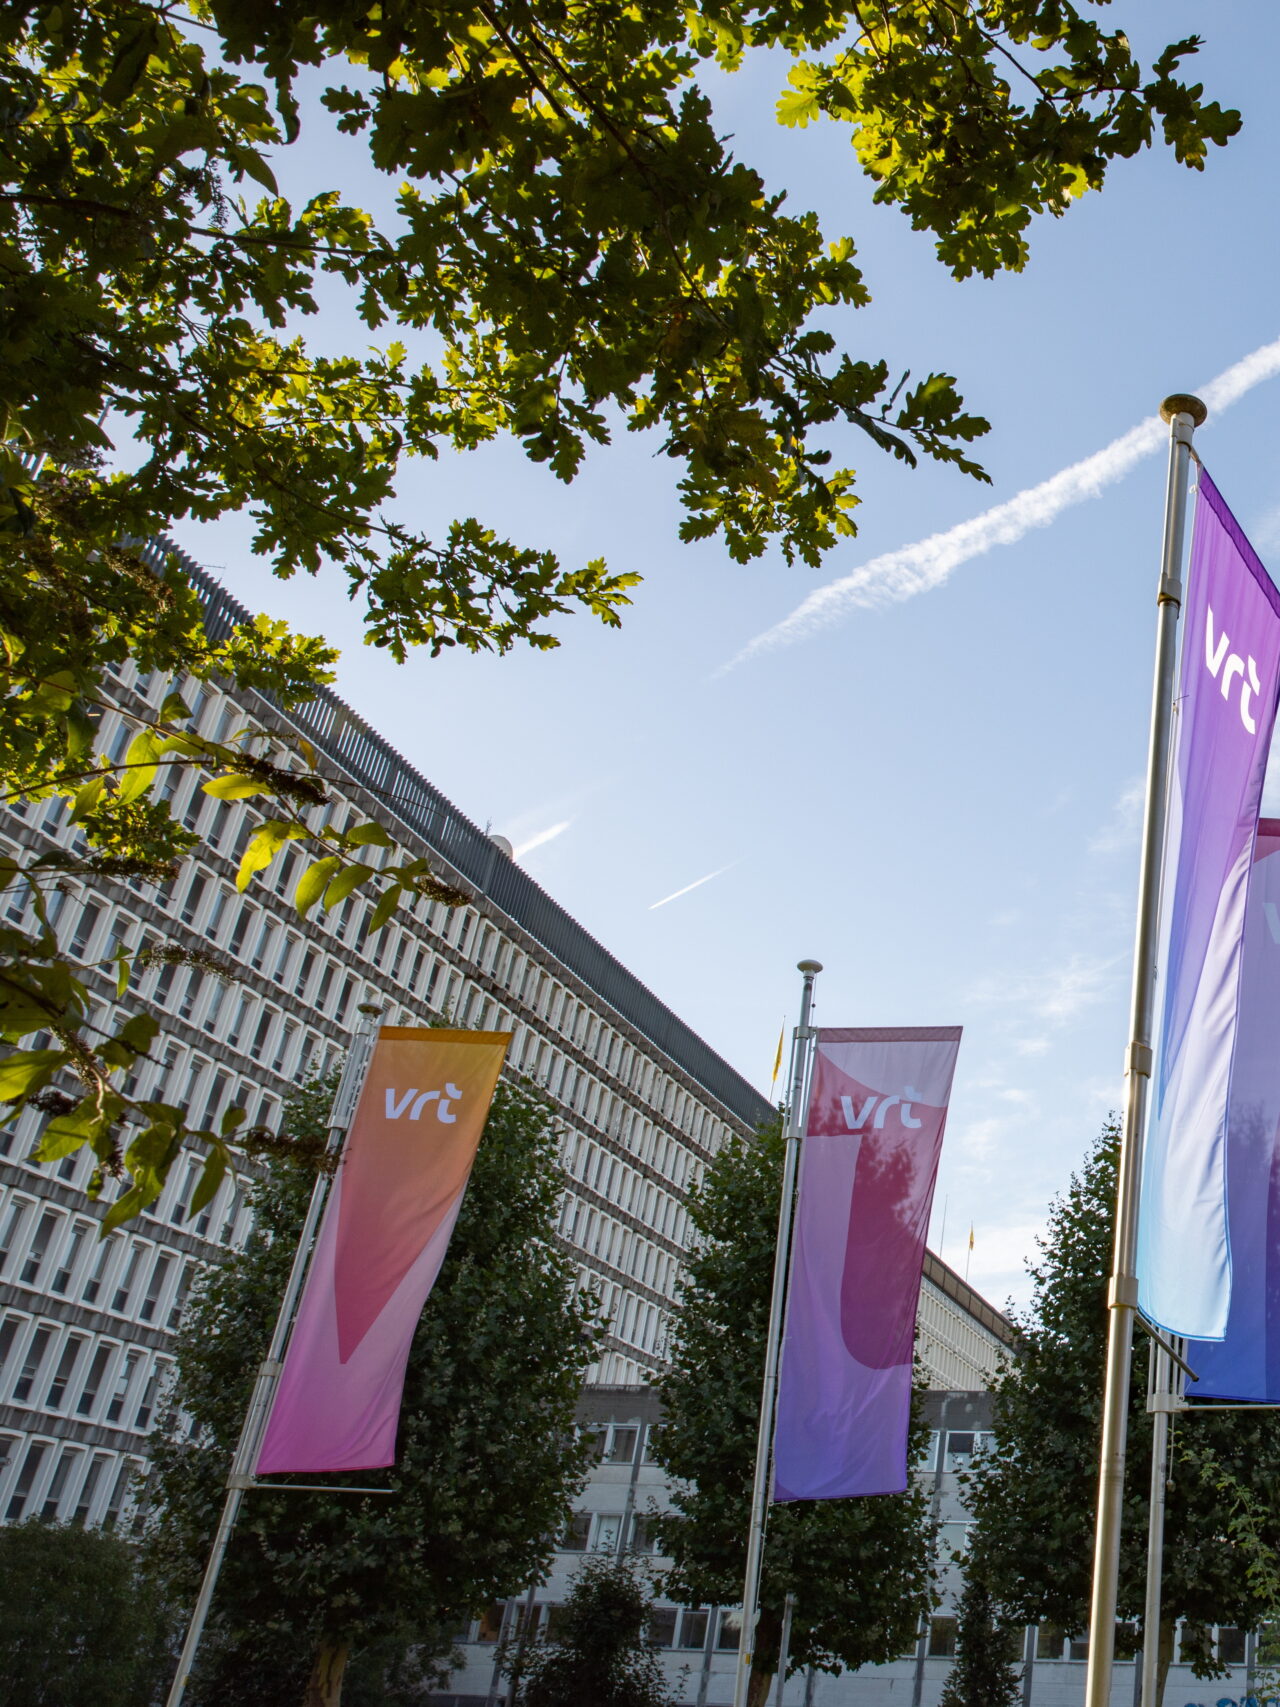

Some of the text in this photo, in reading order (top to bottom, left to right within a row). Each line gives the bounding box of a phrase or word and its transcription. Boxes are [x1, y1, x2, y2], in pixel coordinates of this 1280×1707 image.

[1205, 602, 1261, 735] vrt
[385, 1082, 463, 1124] vrt
[840, 1085, 922, 1130] vrt
